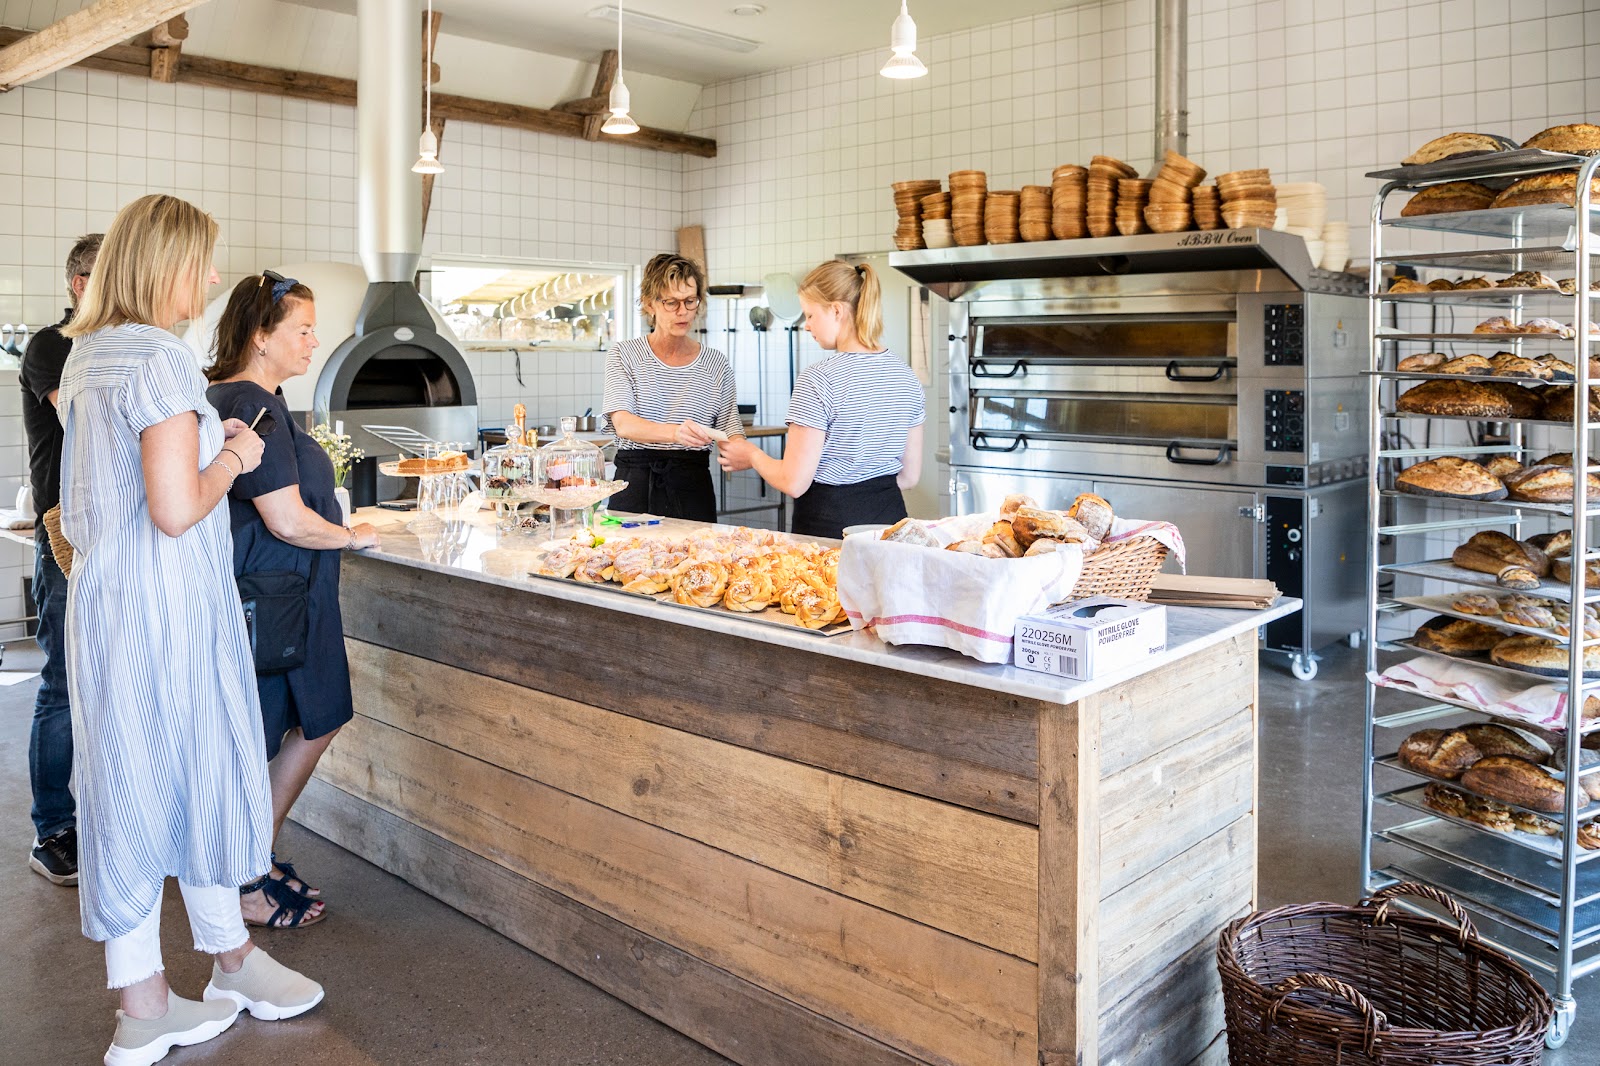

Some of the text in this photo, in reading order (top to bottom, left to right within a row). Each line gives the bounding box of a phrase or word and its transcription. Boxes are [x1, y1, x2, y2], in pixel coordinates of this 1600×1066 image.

[1177, 231, 1252, 247] ABBU Oven
[1021, 626, 1072, 646] 220256M
[1098, 624, 1120, 638] NITRILE
[1121, 618, 1139, 631] GLOVE
[1099, 628, 1135, 646] POWDER FREE
